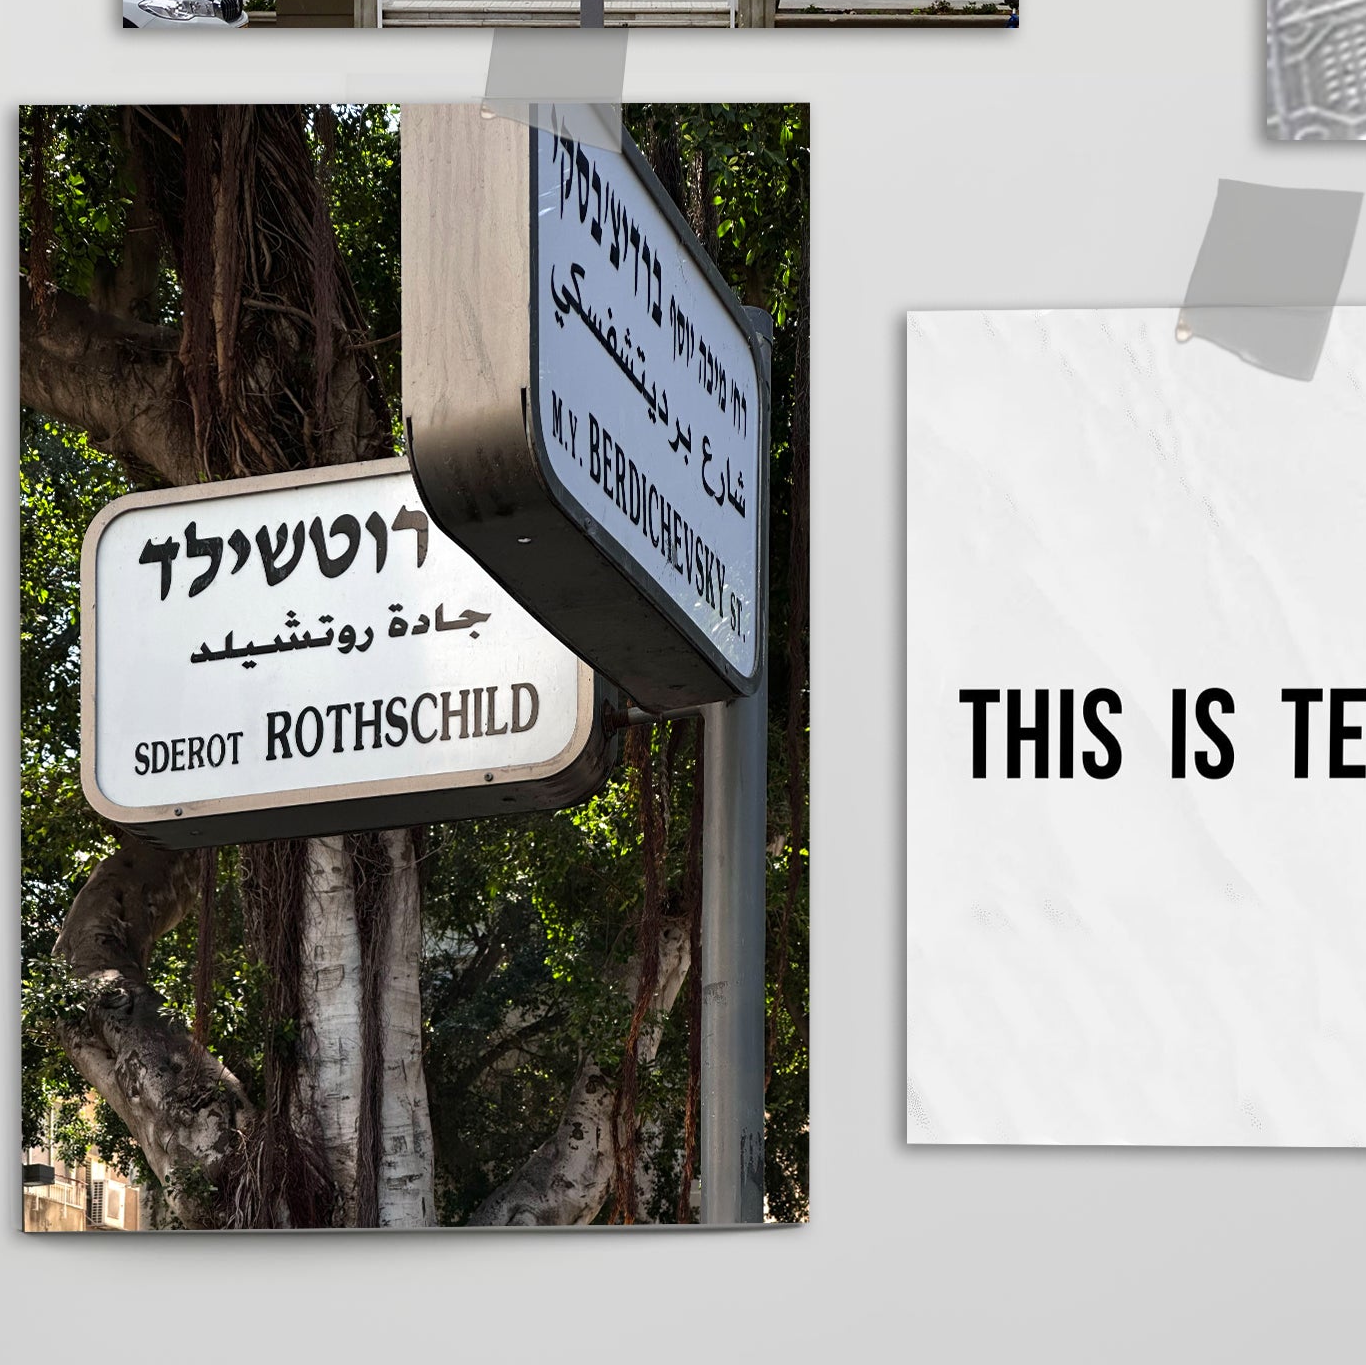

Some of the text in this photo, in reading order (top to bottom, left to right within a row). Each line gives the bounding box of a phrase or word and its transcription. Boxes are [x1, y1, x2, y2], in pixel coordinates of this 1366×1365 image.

[670, 294, 694, 368] יוסף
[698, 334, 727, 413] מיכה
[701, 435, 746, 518] شارع
[139, 504, 430, 601] רוטשילד
[588, 412, 726, 619] BERDICHEVSKY
[730, 591, 746, 643] ST.
[190, 602, 492, 669] جادة روتشيلد
[134, 682, 541, 776] SDEROT ROTHSCHILD
